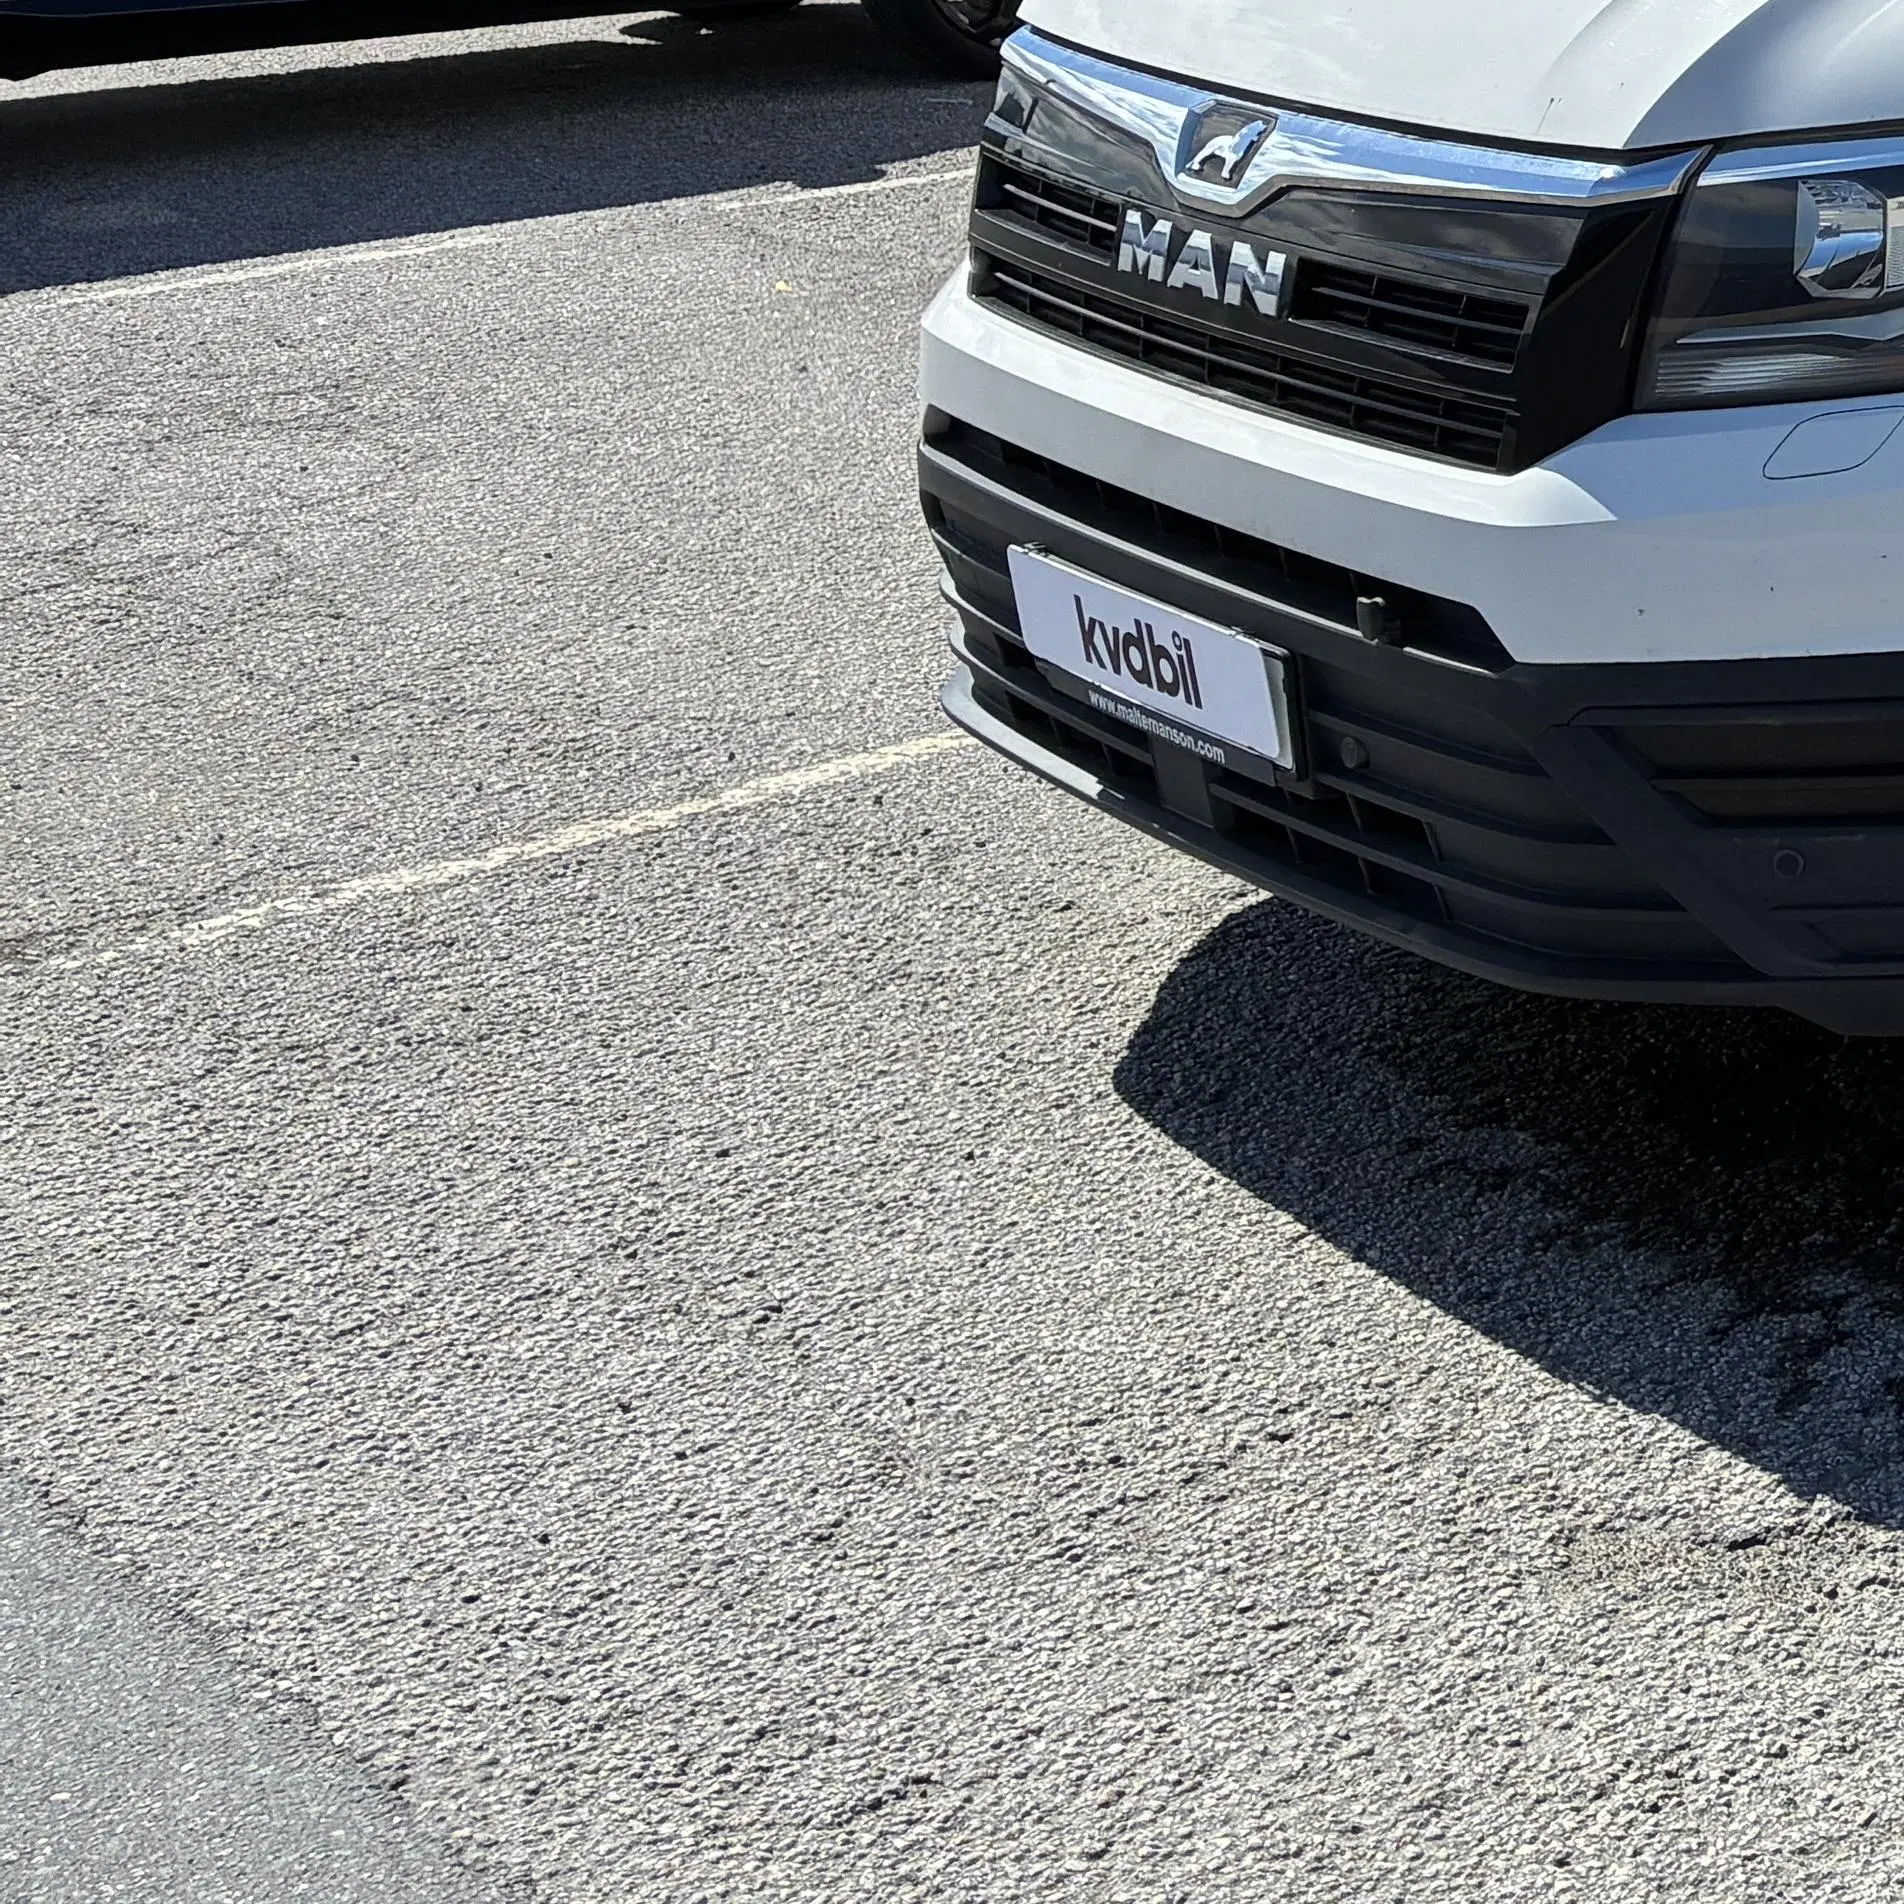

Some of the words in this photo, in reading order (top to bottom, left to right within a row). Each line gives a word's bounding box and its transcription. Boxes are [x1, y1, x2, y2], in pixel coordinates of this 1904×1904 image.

[1118, 209, 1287, 317] MAN
[1073, 594, 1203, 710] kvdbil
[1088, 689, 1226, 765] www.maltemanson.com
